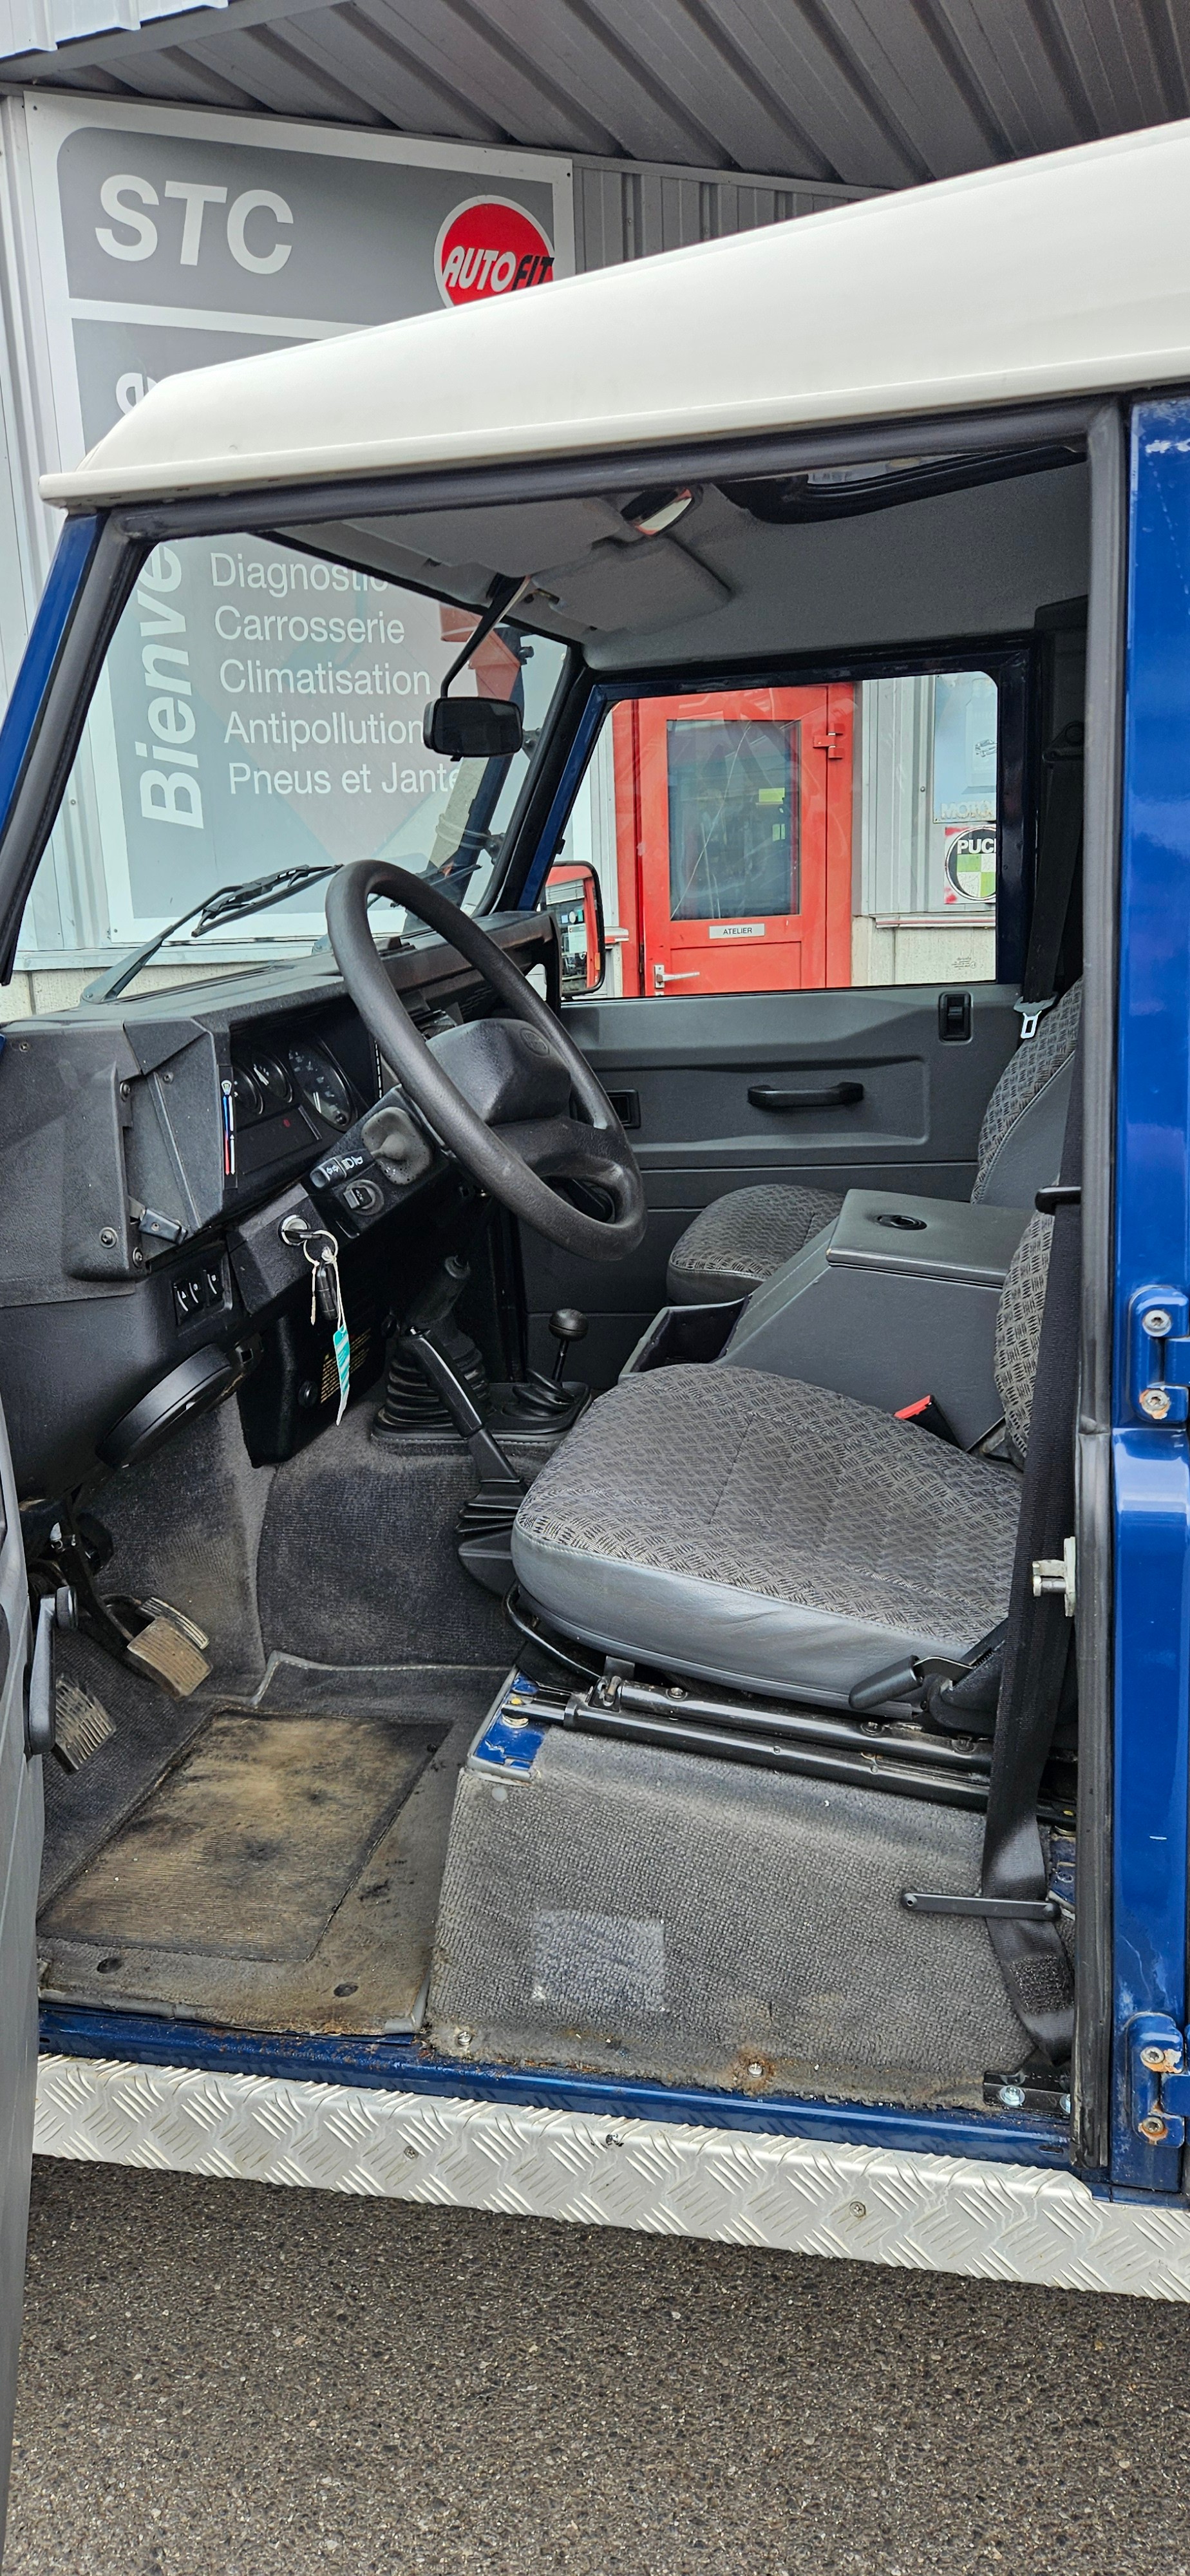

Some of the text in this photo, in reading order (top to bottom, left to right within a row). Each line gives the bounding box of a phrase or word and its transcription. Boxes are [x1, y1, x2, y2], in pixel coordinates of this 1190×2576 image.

[95, 175, 294, 275] STC
[214, 605, 404, 643] Carrosserie
[220, 659, 430, 695] Climatisation
[224, 711, 424, 752] Antipollution
[229, 762, 331, 794] Pneus
[341, 764, 372, 793] et
[941, 800, 996, 820] MOTO
[957, 838, 996, 854] PUC
